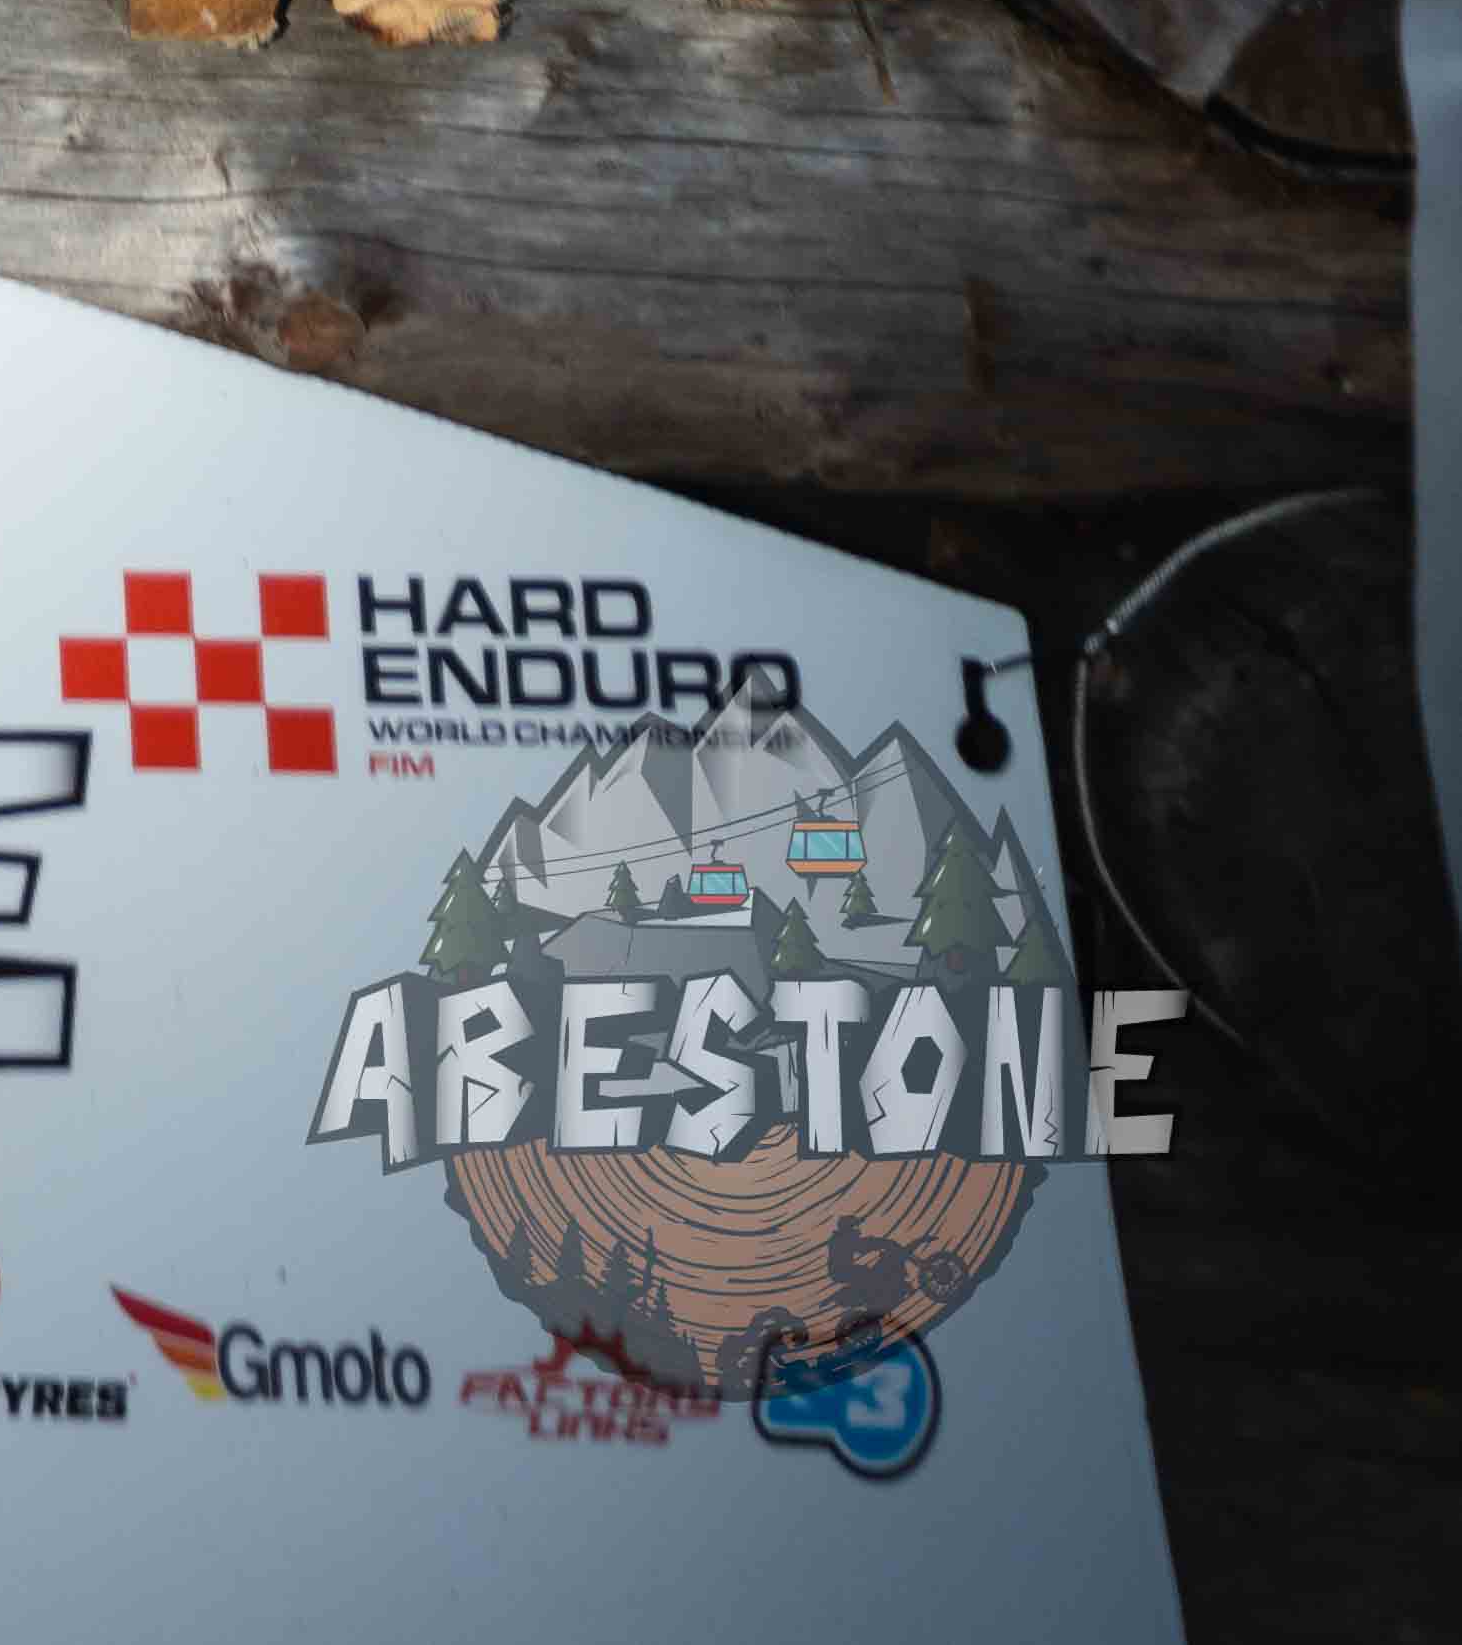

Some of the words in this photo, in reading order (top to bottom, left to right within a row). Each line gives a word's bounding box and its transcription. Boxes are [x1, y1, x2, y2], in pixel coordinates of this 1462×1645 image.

[357, 573, 653, 640] HARD
[362, 646, 804, 714] ENDURO
[368, 717, 508, 748] WORLD
[368, 752, 436, 780] FIM
[216, 1321, 432, 1411] Gmoto
